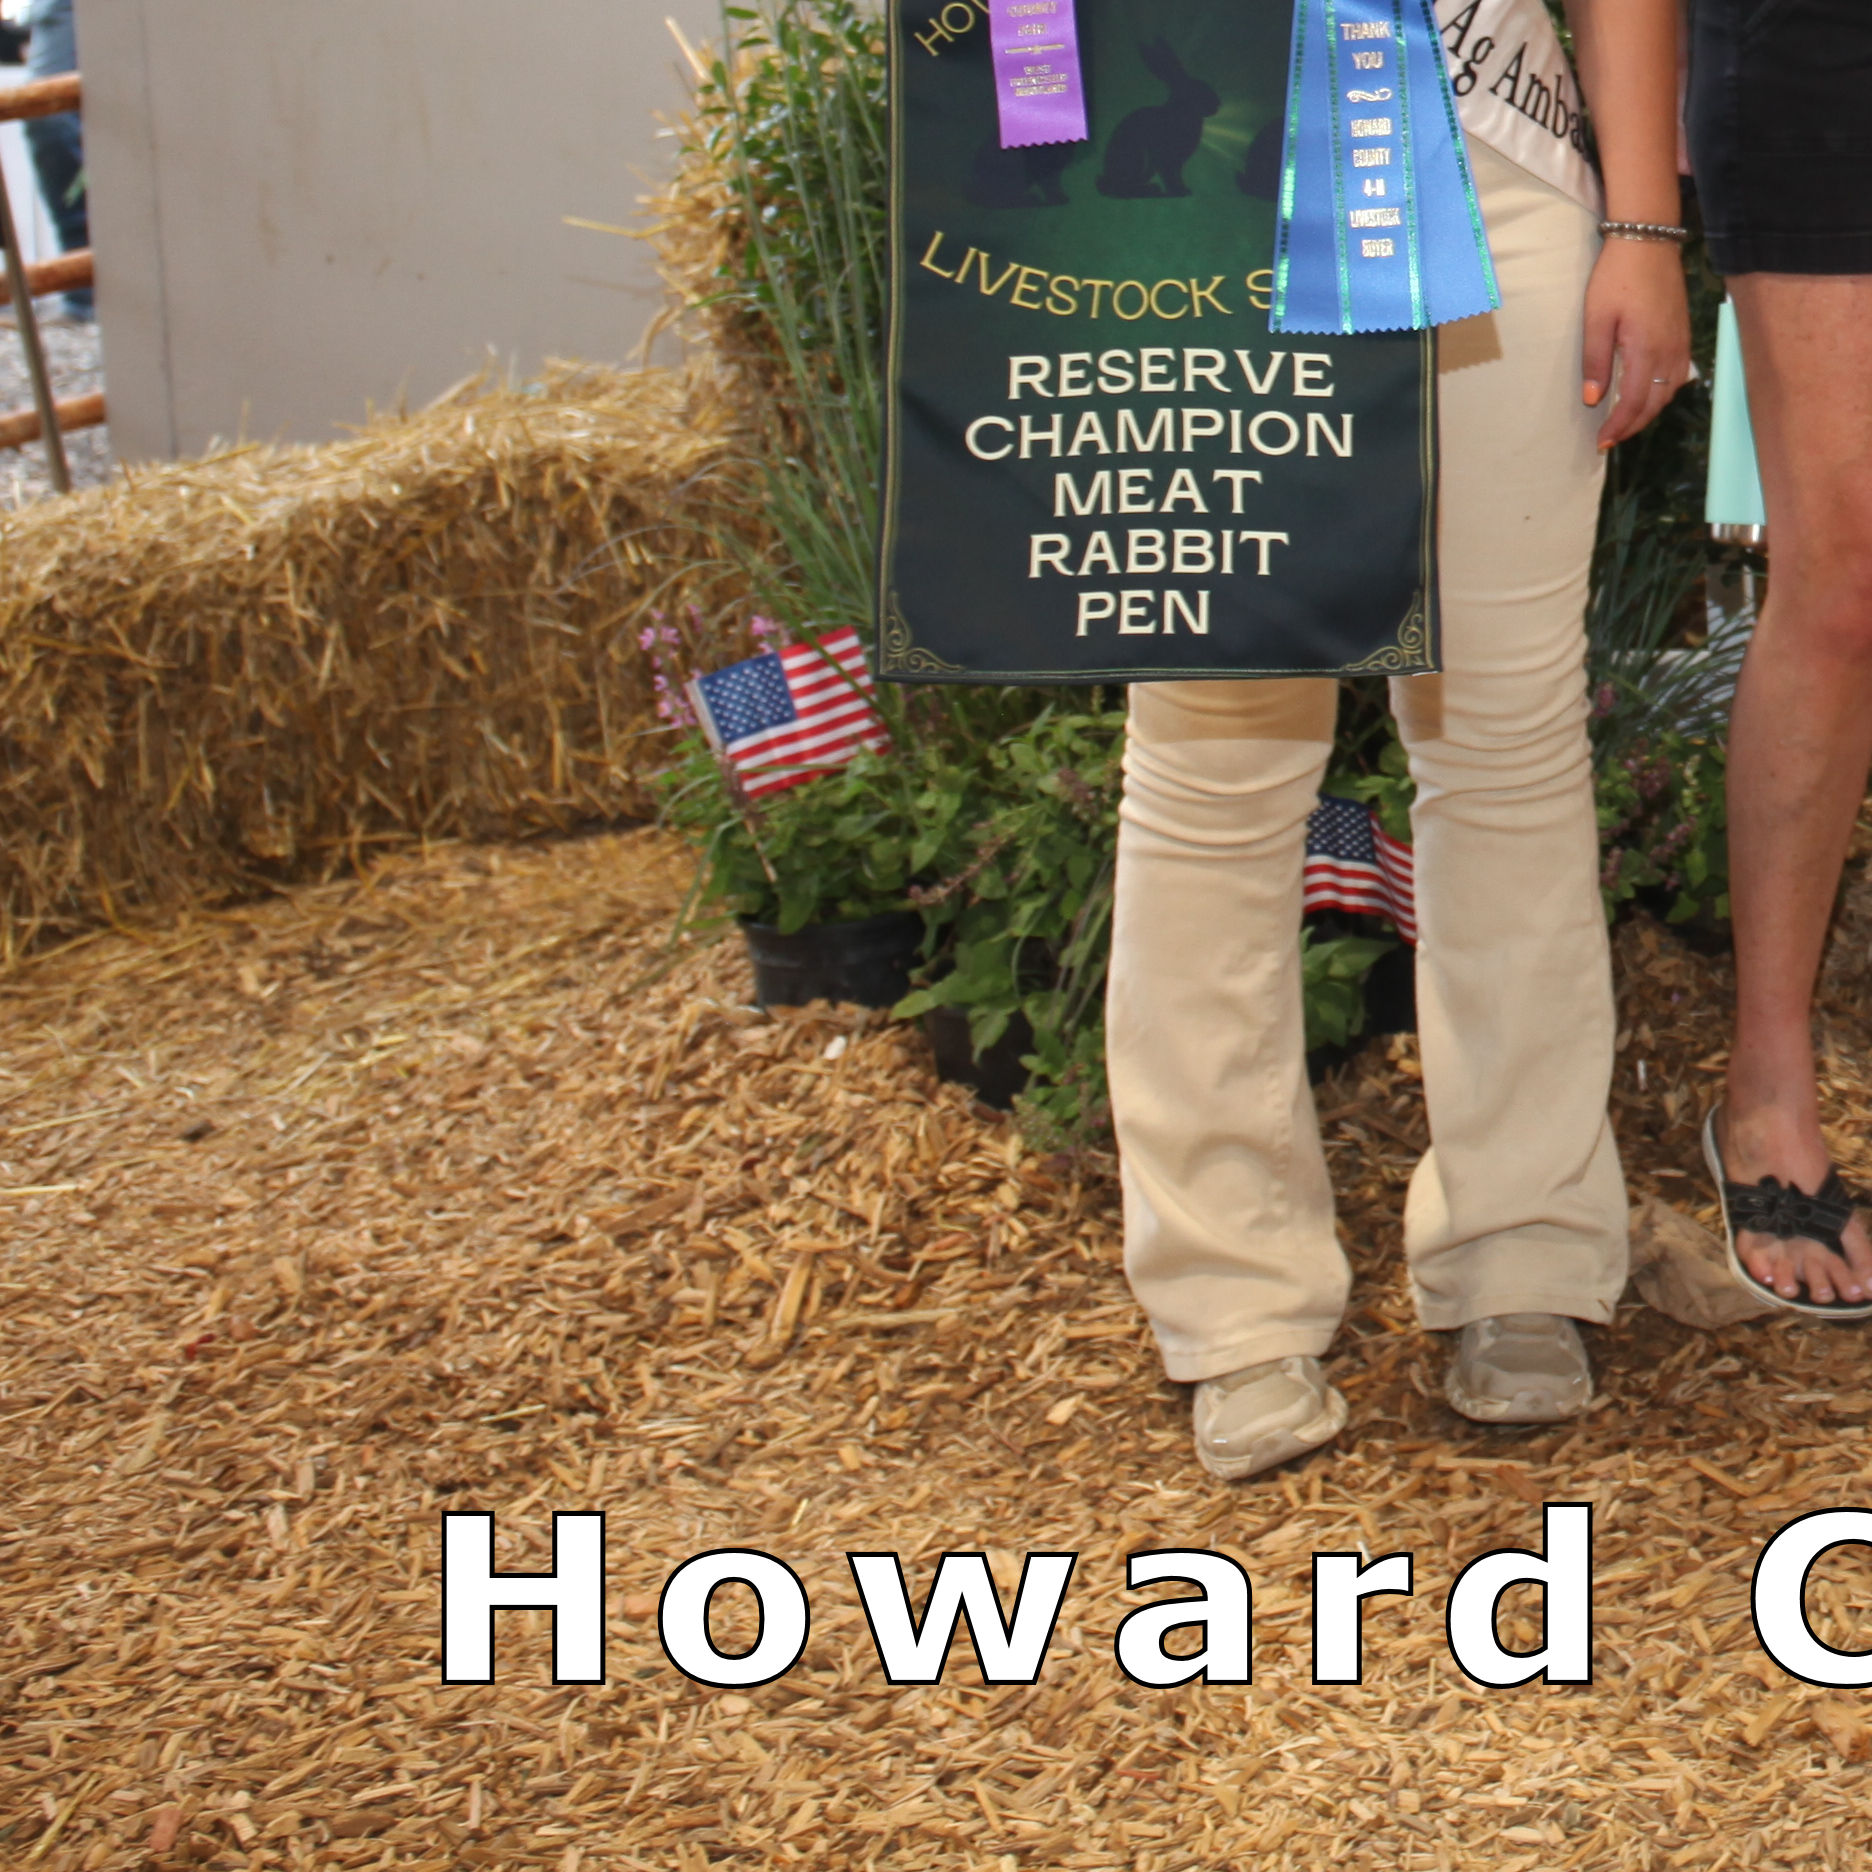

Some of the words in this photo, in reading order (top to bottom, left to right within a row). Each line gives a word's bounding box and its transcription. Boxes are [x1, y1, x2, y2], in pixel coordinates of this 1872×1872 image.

[1340, 21, 1393, 41] THANK
[1352, 51, 1384, 70] YOU
[919, 230, 1234, 321] LIVESTOCK
[1007, 347, 1336, 400] RESERVE
[964, 407, 1354, 461] CHAMPION
[1053, 468, 1264, 518] MEAT
[1027, 528, 1290, 579] RABBIT
[1074, 589, 1211, 638] PEN
